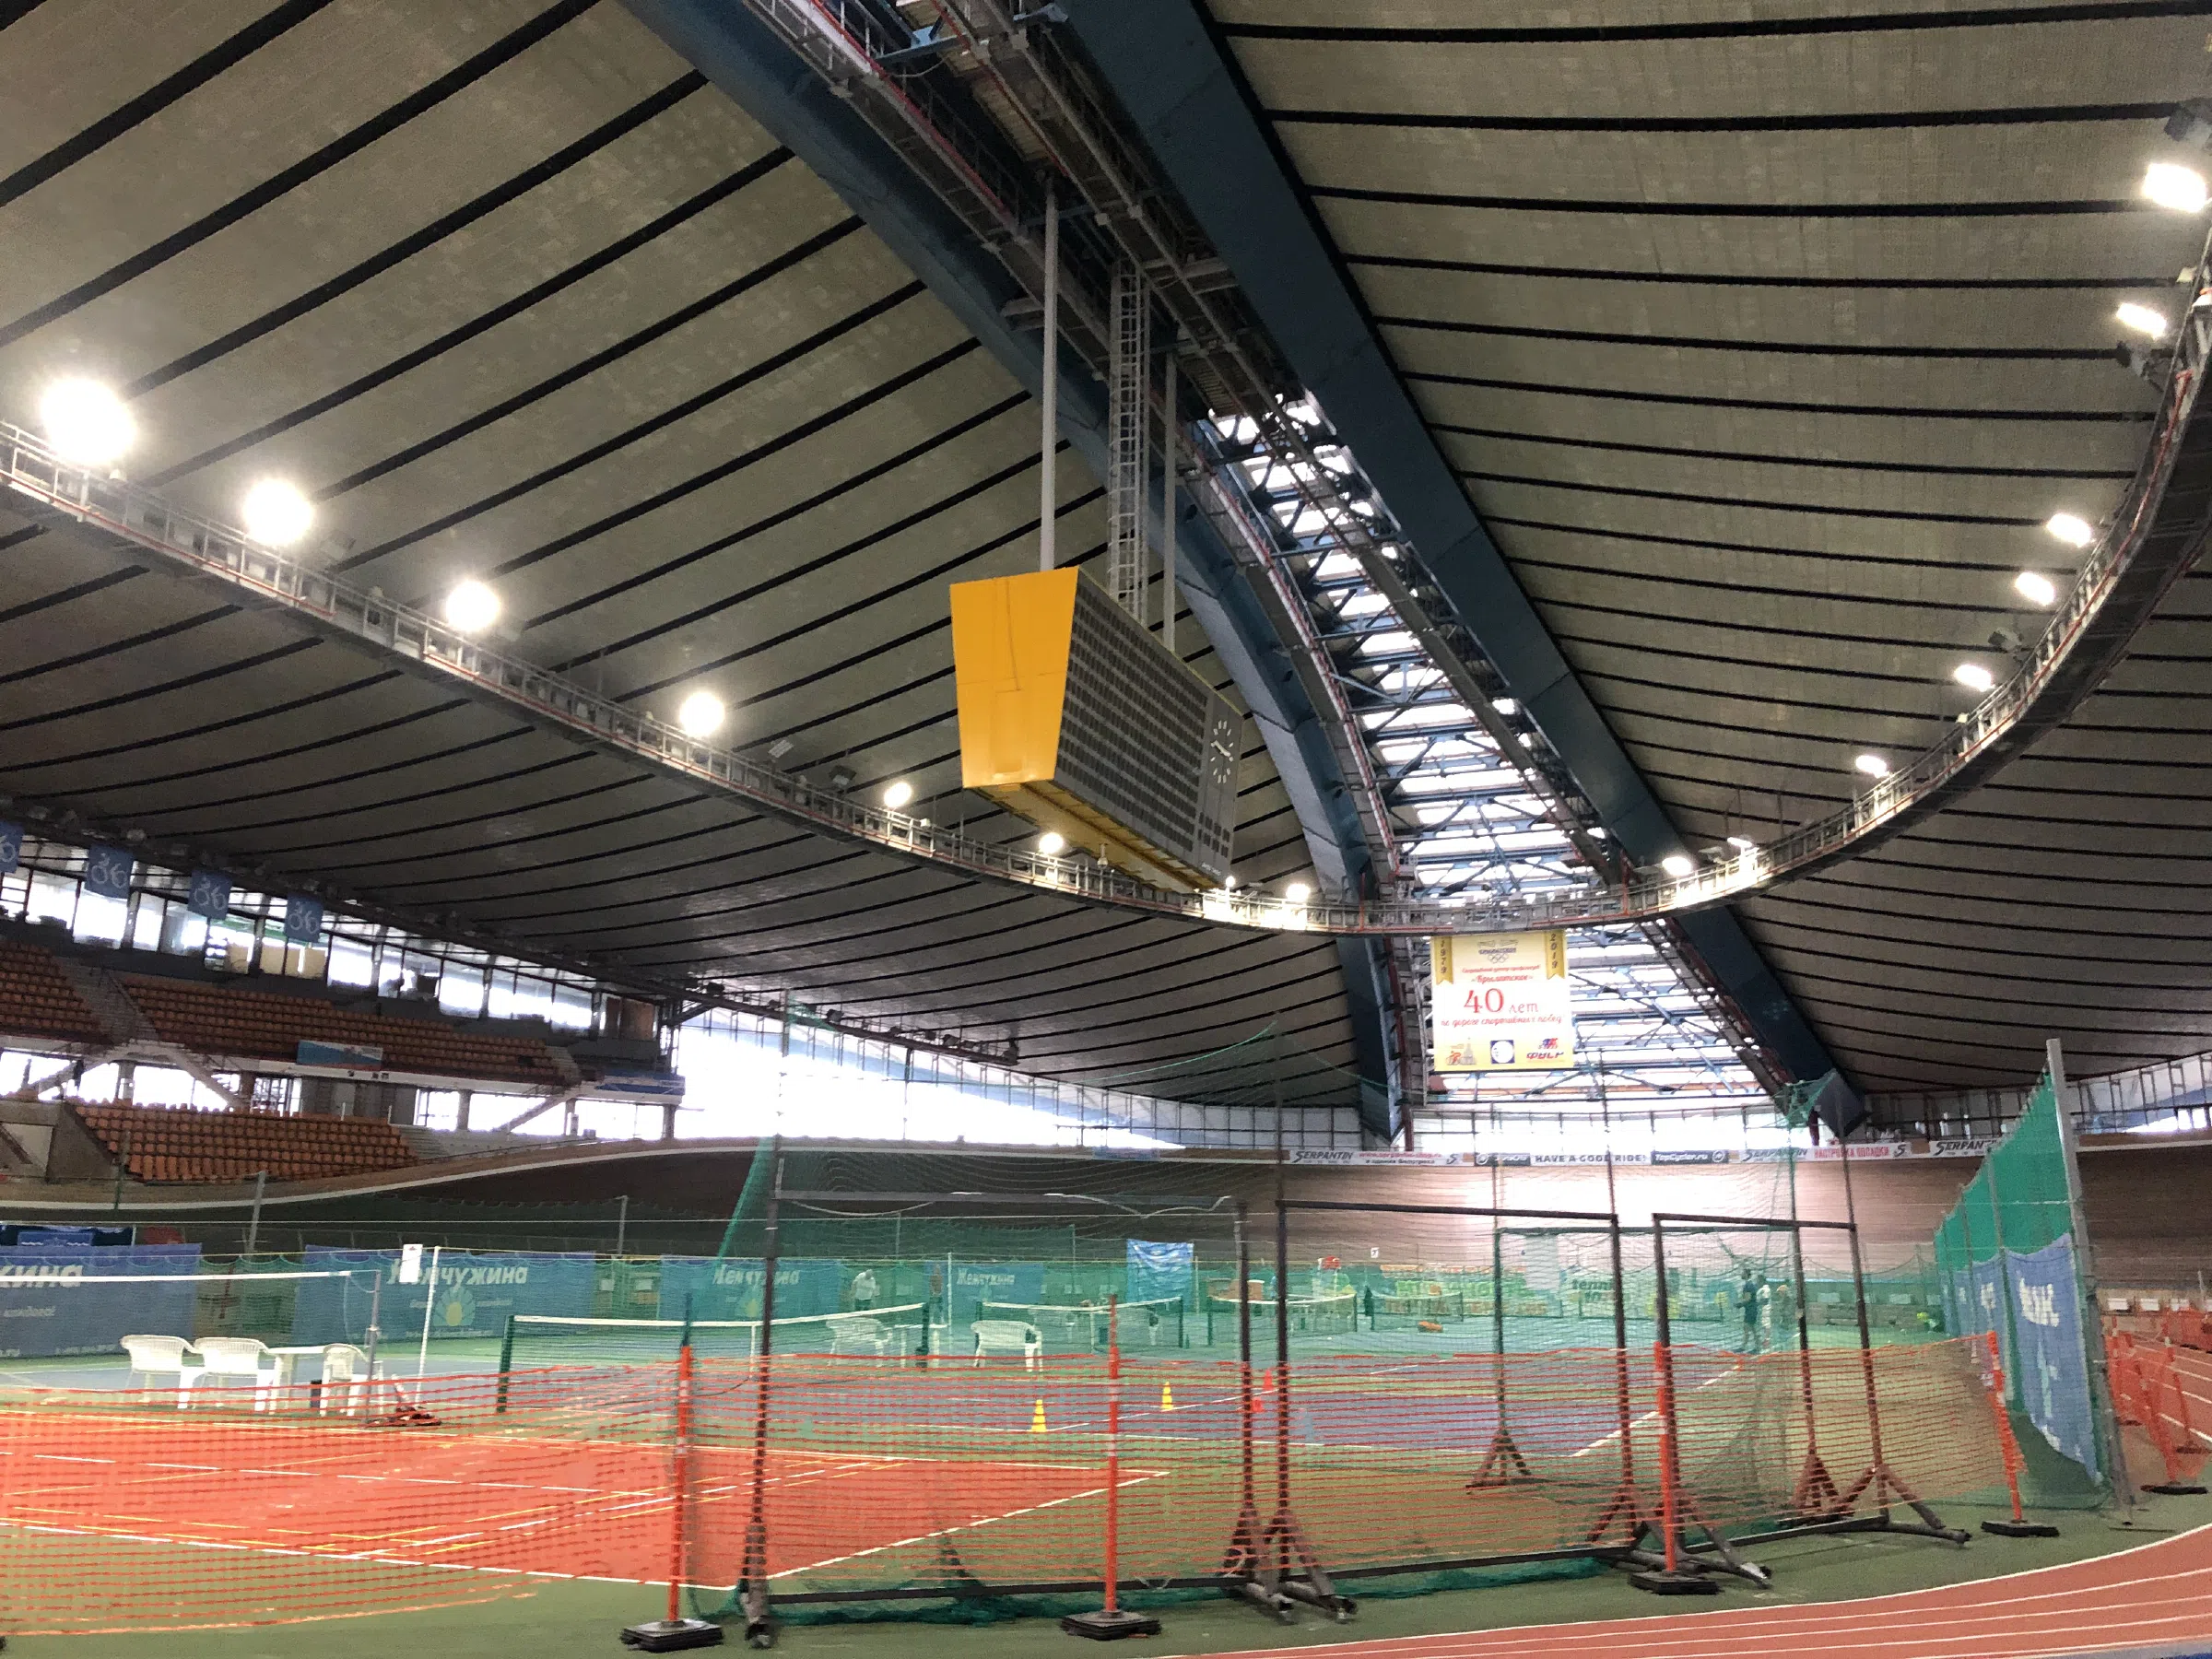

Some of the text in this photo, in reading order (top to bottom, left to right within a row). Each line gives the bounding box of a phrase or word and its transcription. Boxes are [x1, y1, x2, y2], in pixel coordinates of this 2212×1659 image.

[1549, 933, 1559, 969] 2019
[1464, 988, 1538, 1013] 40 лет
[1934, 1140, 1998, 1156] SERPAN
[1291, 1151, 1354, 1163] SERPANTIN
[1535, 1154, 1565, 1163] HAVE
[1569, 1154, 1577, 1162] A
[1615, 1153, 1646, 1163] RIDE!
